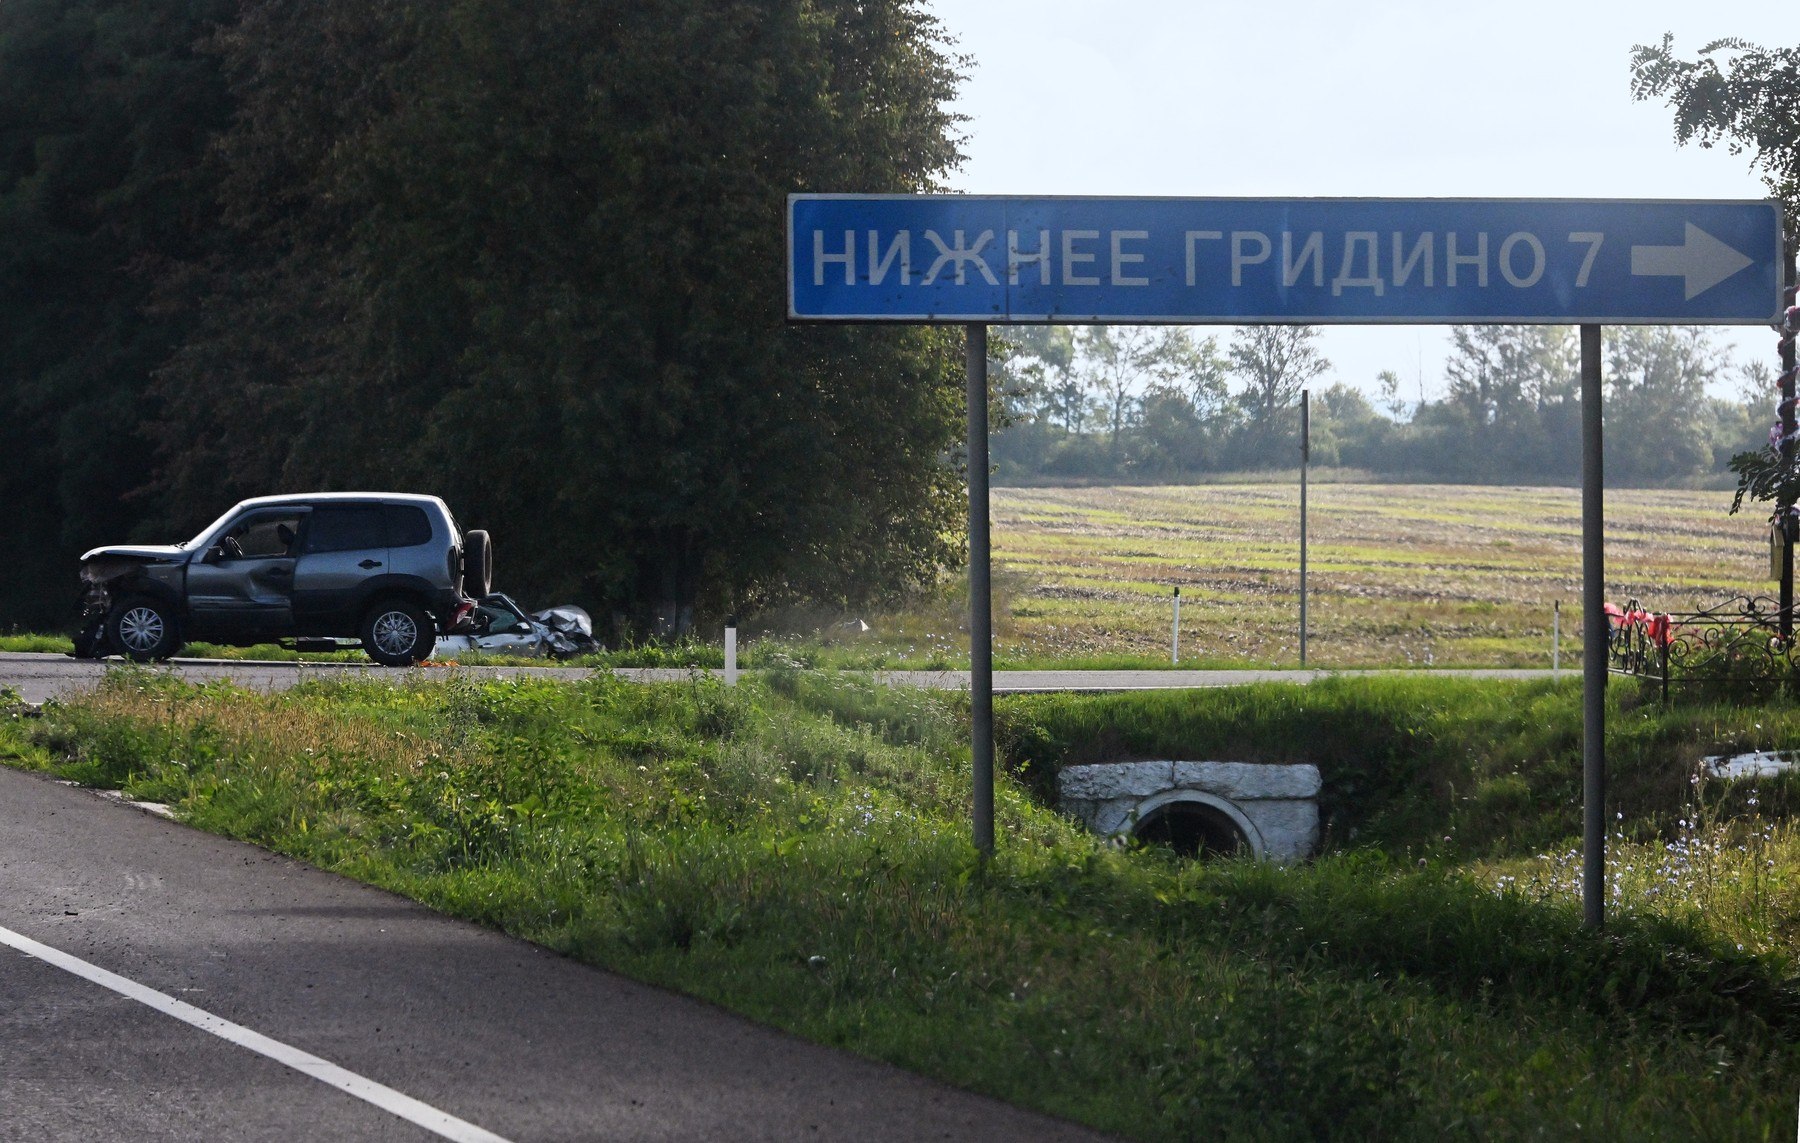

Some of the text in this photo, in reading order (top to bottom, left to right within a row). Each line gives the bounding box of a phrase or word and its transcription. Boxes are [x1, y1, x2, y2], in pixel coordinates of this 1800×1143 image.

[812, 229, 1605, 297] НИЖНЕЕ ГРИДИНО 7
